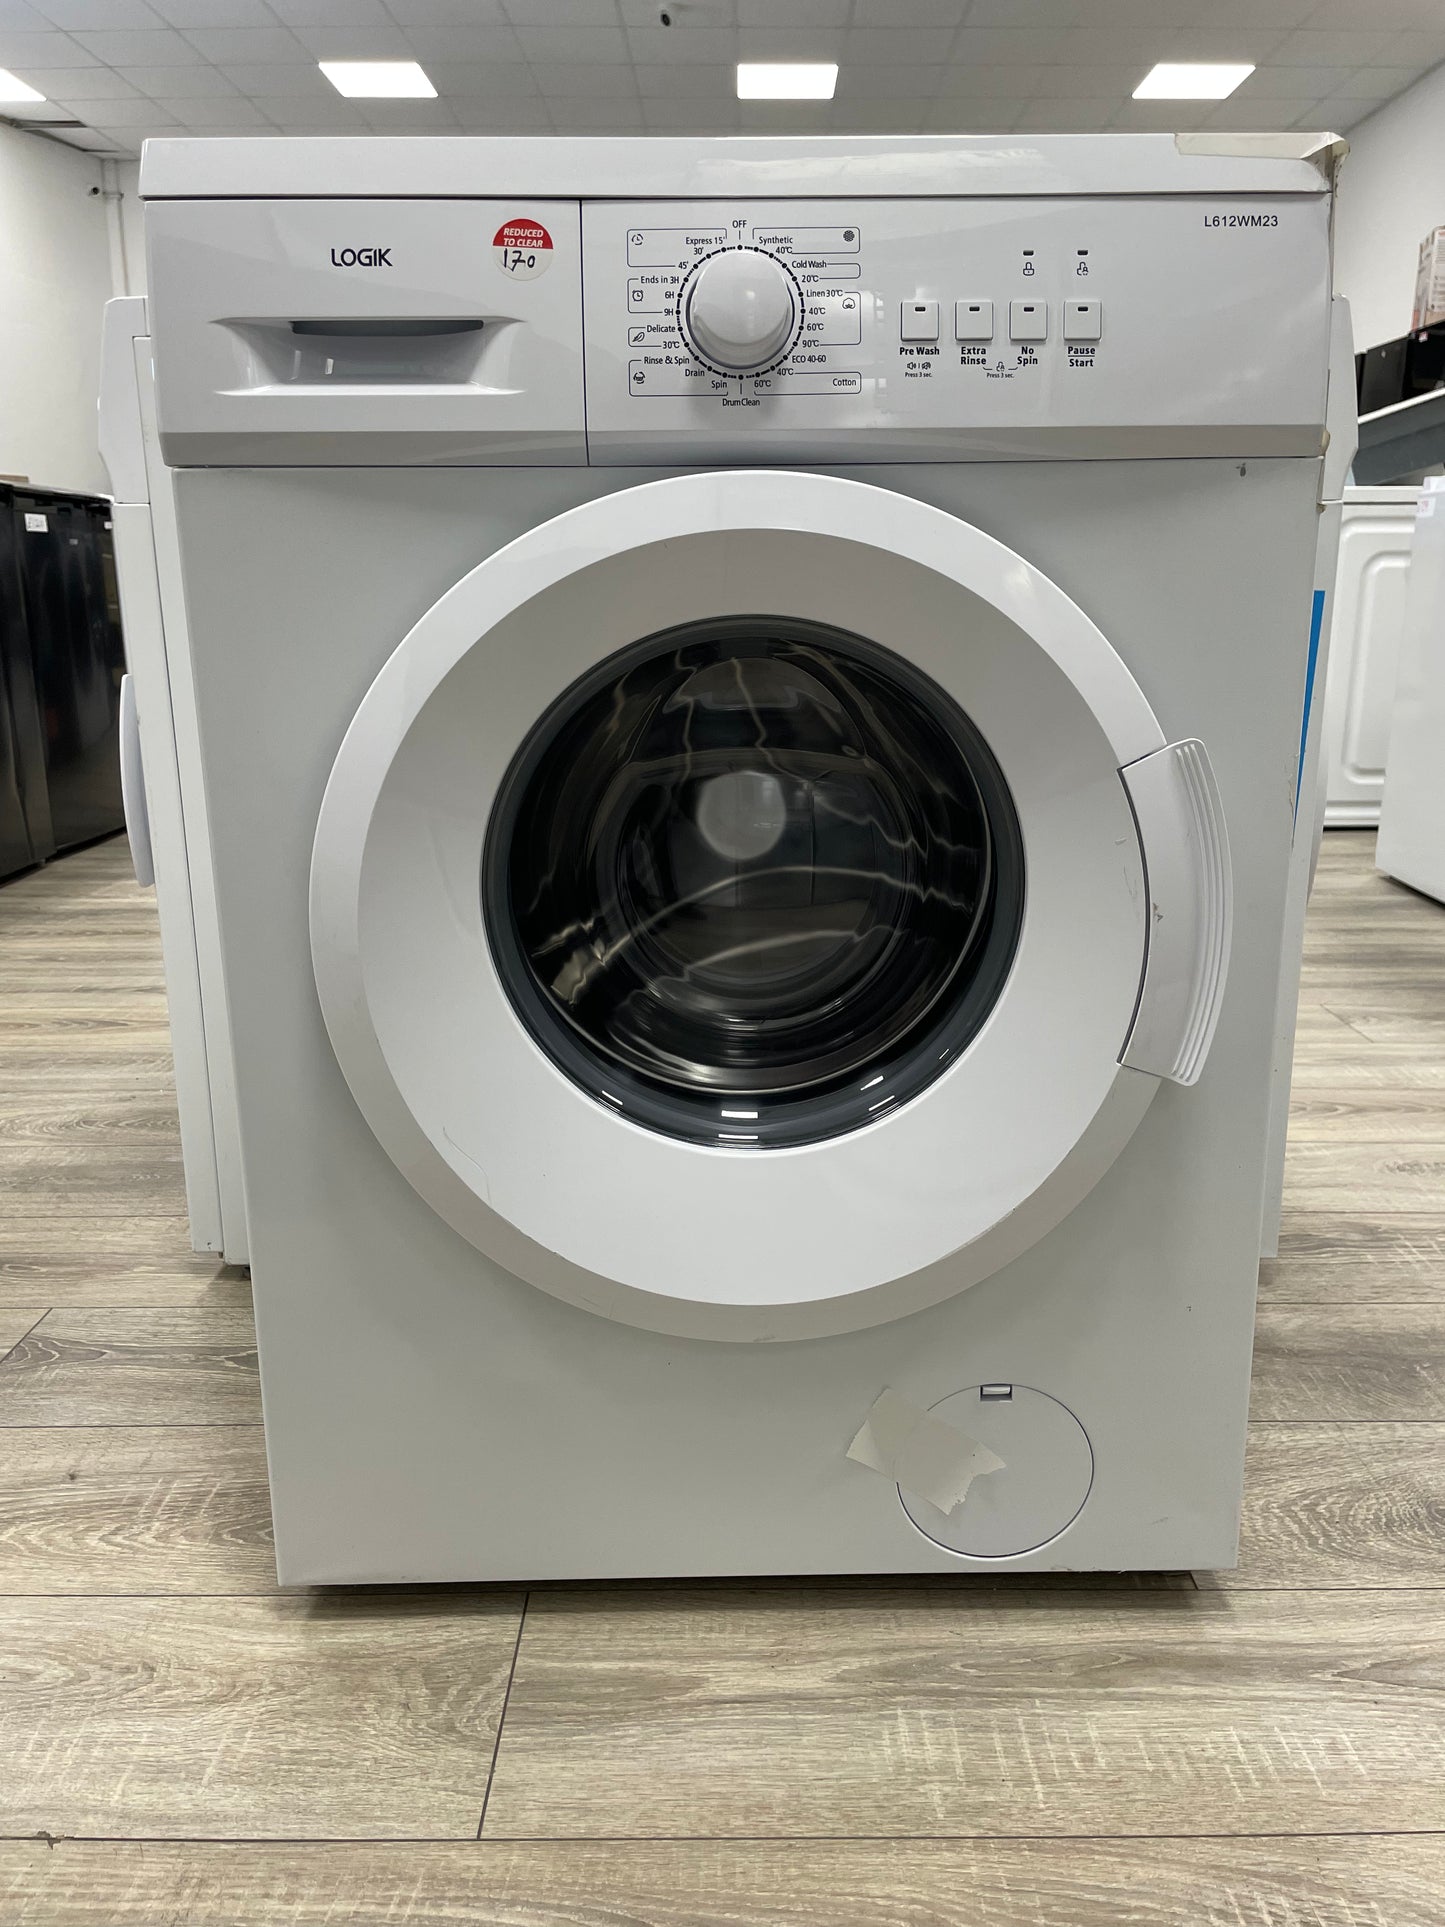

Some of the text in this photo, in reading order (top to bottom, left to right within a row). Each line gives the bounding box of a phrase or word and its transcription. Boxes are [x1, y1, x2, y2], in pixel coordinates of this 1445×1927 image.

[1204, 215, 1278, 227] L612WM23
[503, 228, 544, 238] REDUCED
[504, 238, 544, 247] TO CLEAR
[685, 237, 712, 246] Express
[759, 236, 793, 245] Synthetic
[331, 248, 393, 267] LOGIK
[504, 248, 535, 272] 170
[809, 260, 826, 268] Wash
[806, 289, 825, 297] Linen
[900, 347, 940, 355] Pre Wash
[961, 346, 986, 355] Extra
[1021, 346, 1034, 354] No
[665, 356, 673, 364] &
[674, 355, 690, 366] Spin
[807, 355, 826, 363] 40-60
[960, 356, 986, 365] Rinse
[1017, 356, 1038, 366] Spin
[1069, 359, 1094, 367] Start
[685, 369, 705, 377] Drain
[711, 380, 727, 390] Spin
[833, 378, 856, 386] Cotton
